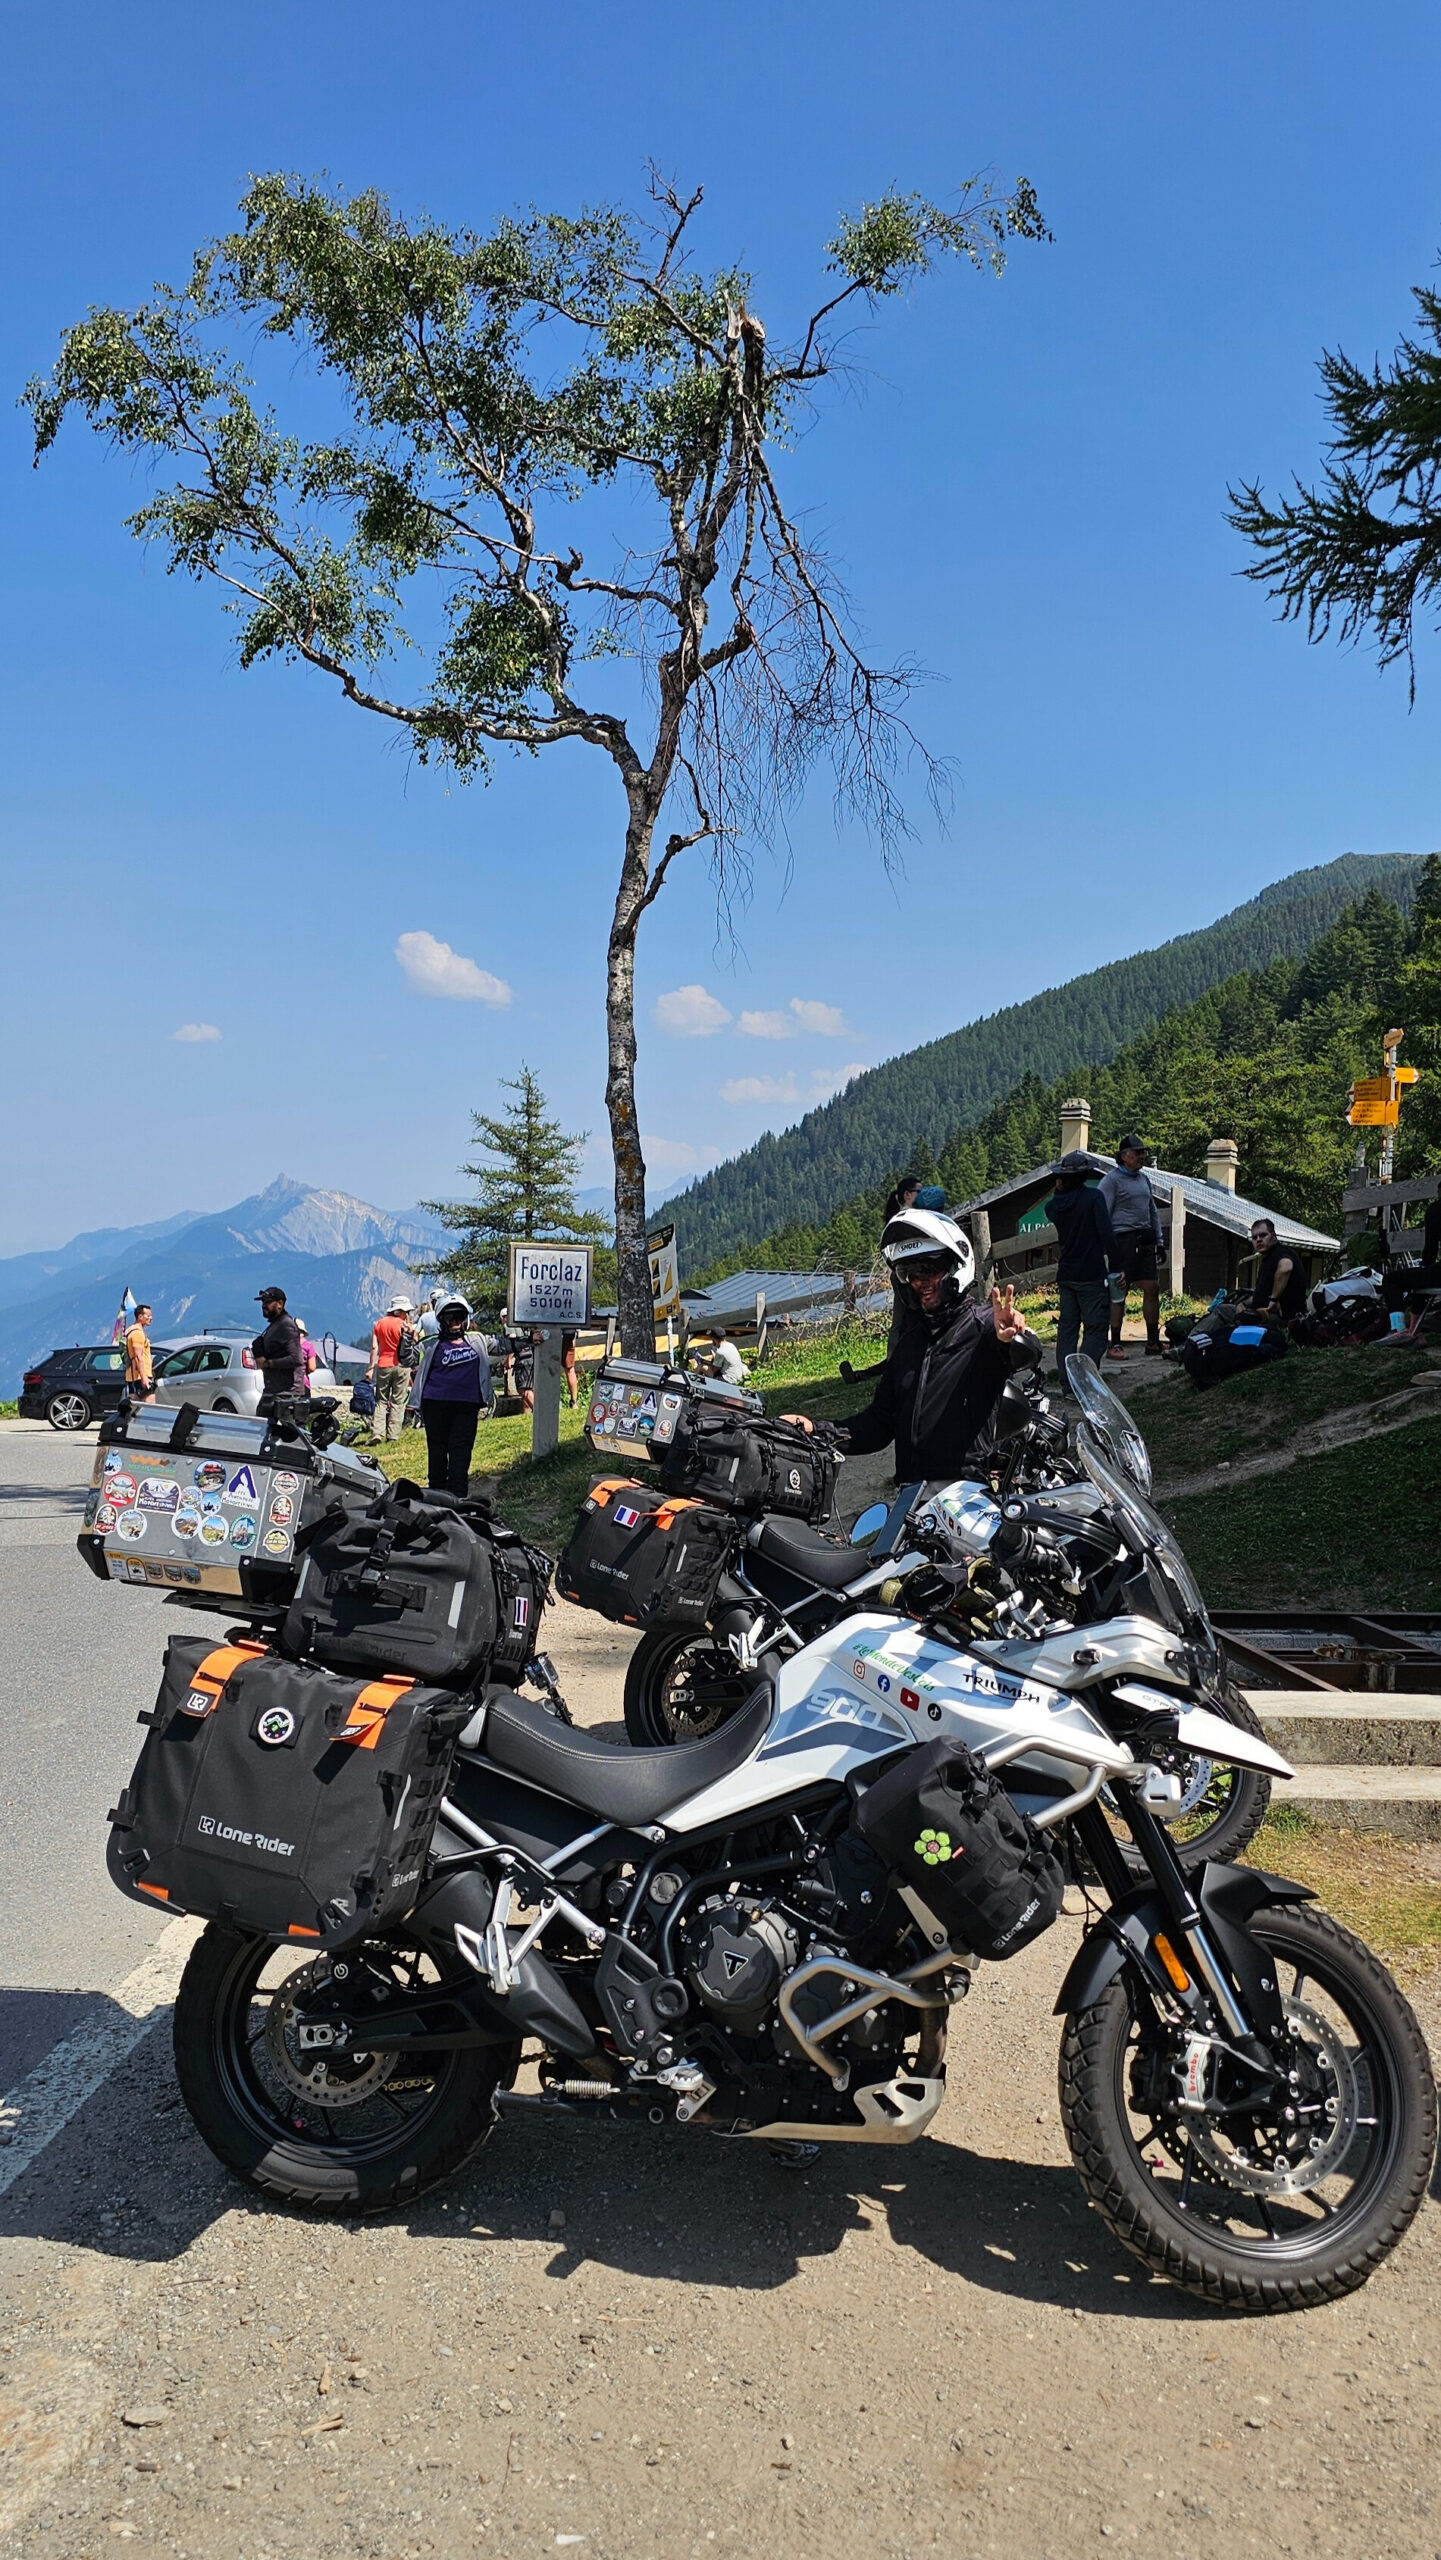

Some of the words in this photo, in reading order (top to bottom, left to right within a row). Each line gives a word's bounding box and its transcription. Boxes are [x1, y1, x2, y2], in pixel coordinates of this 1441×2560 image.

[521, 1256, 582, 1281] Forclaz
[529, 1284, 560, 1295] 1527
[562, 1288, 573, 1296] m
[530, 1297, 562, 1308] 5010
[563, 1298, 572, 1309] ft
[559, 1311, 583, 1319] A.C.S.
[441, 1347, 478, 1365] Triump
[978, 1510, 1001, 1522] TRIU
[963, 1673, 1040, 1703] TRIUMPH
[806, 1691, 883, 1728] 900
[216, 1821, 253, 1846] Lone
[254, 1833, 295, 1857] Rider
[1001, 1921, 1025, 1942] Lone
[1019, 1898, 1041, 1922] Rider
[1188, 2053, 1199, 2092] brembo
